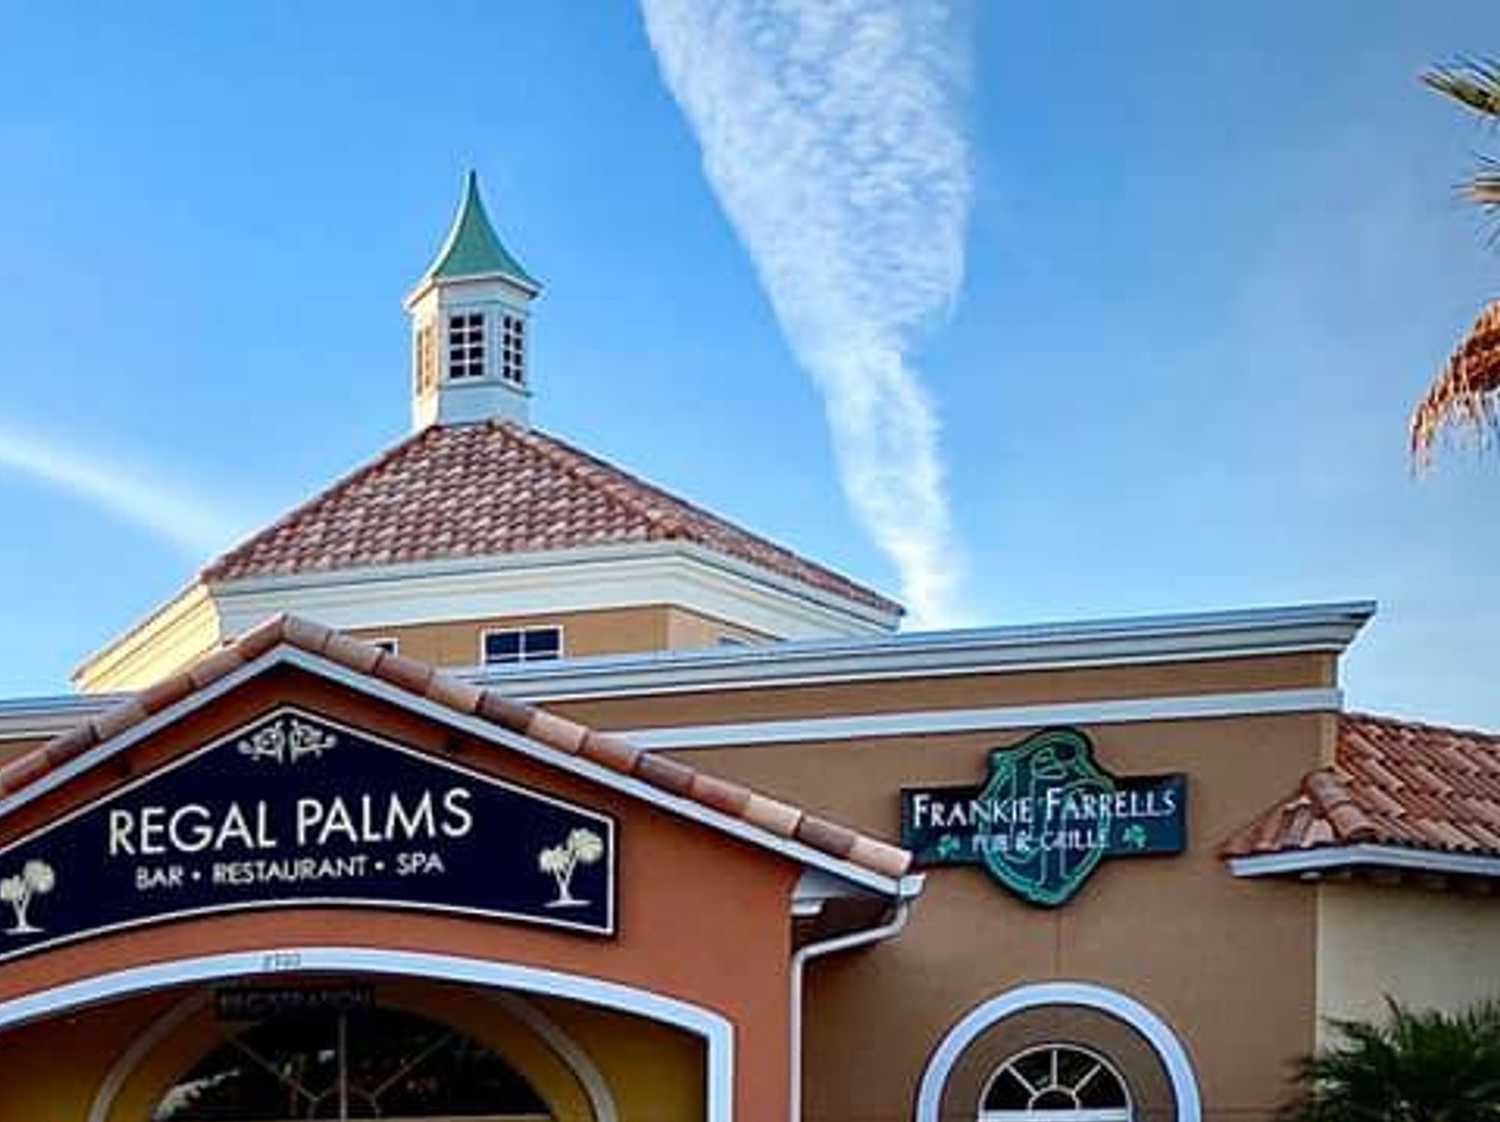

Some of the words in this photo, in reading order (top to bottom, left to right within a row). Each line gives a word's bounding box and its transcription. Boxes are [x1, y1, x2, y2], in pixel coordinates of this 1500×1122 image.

[109, 802, 277, 855] REGAL
[297, 787, 473, 845] PALMS
[912, 794, 1034, 828] FRANKIE
[135, 864, 184, 891] BAR
[212, 856, 366, 884] RESTAURANT
[396, 851, 445, 876] SPA
